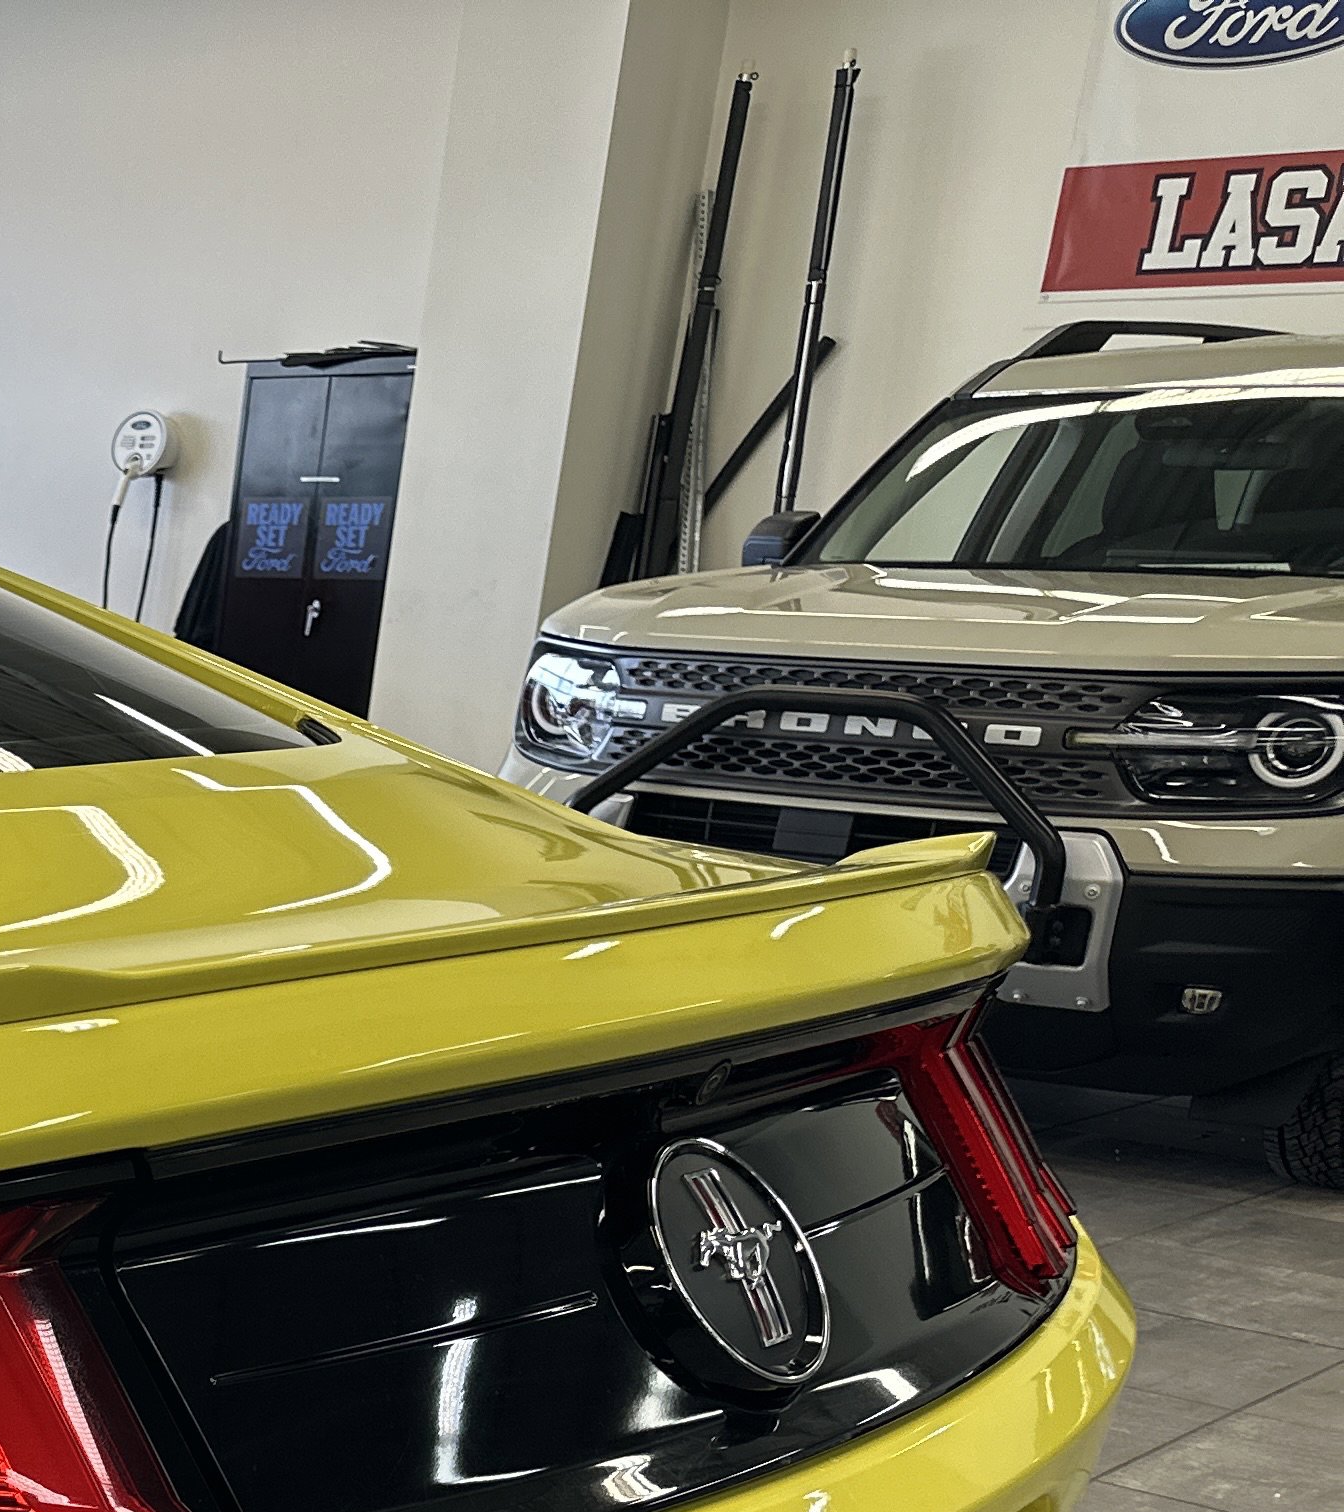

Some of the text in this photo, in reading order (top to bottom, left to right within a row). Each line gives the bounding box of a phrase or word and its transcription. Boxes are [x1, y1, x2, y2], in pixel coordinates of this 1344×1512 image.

[246, 503, 304, 526] READY
[325, 503, 386, 527] READY
[255, 525, 288, 548] SET
[335, 525, 370, 548] SET
[241, 547, 298, 572] Ford
[320, 547, 379, 574] Ford
[661, 703, 1042, 747] BRONO
